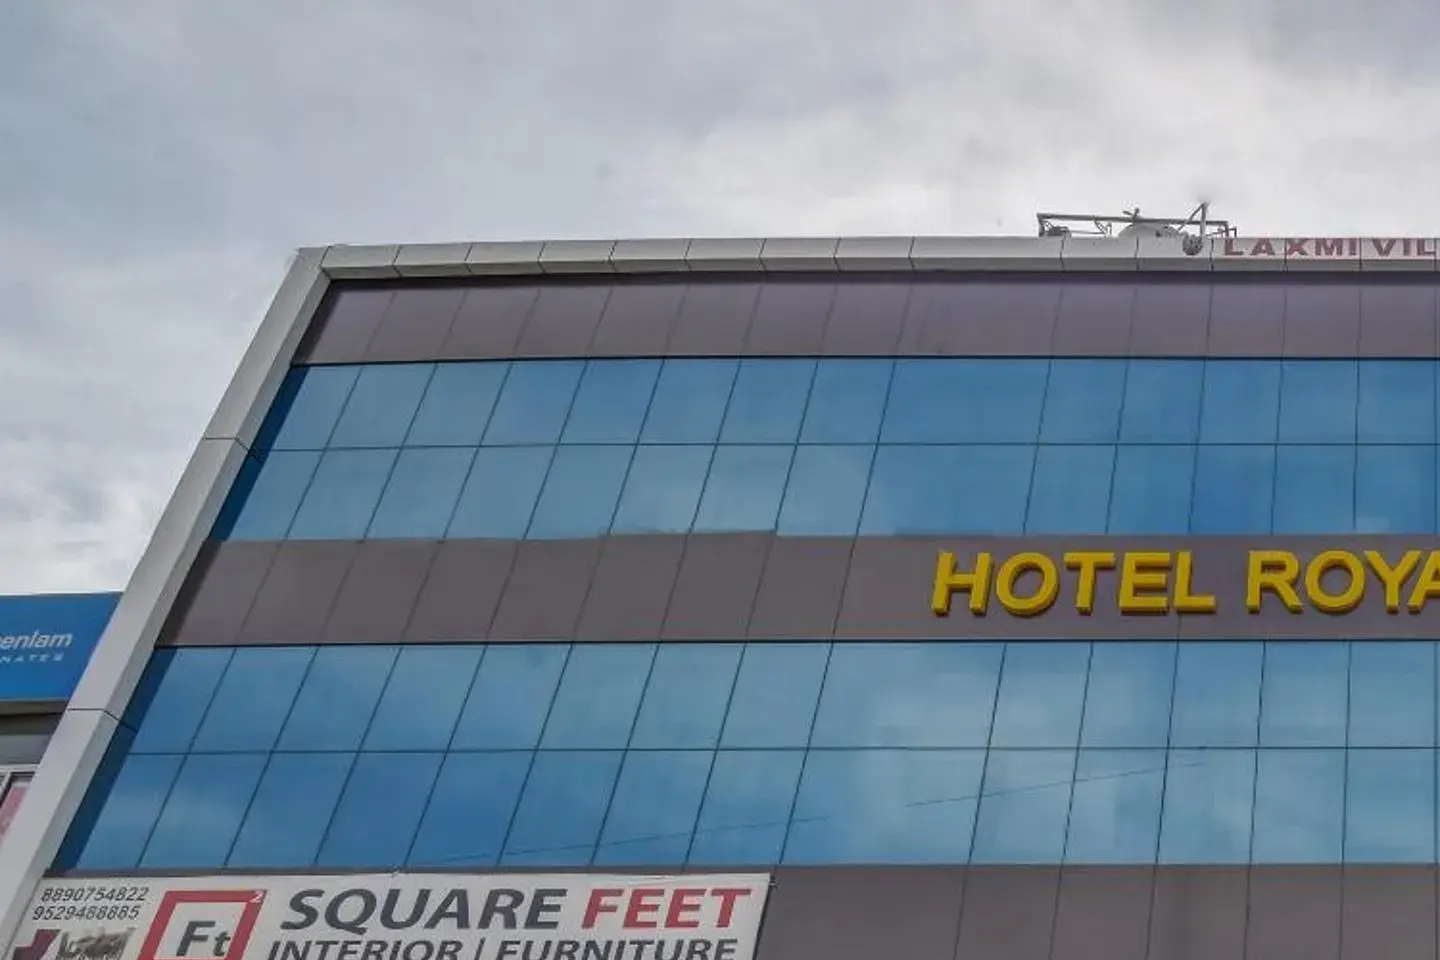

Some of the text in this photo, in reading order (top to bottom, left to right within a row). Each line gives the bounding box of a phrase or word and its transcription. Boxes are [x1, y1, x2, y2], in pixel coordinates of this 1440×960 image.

[1223, 237, 1357, 257] LAXMI
[932, 550, 1215, 616] HOTEL
[0, 629, 72, 649] enlam
[280, 888, 752, 931] SQUARE FEET
[176, 921, 231, 957] Ft
